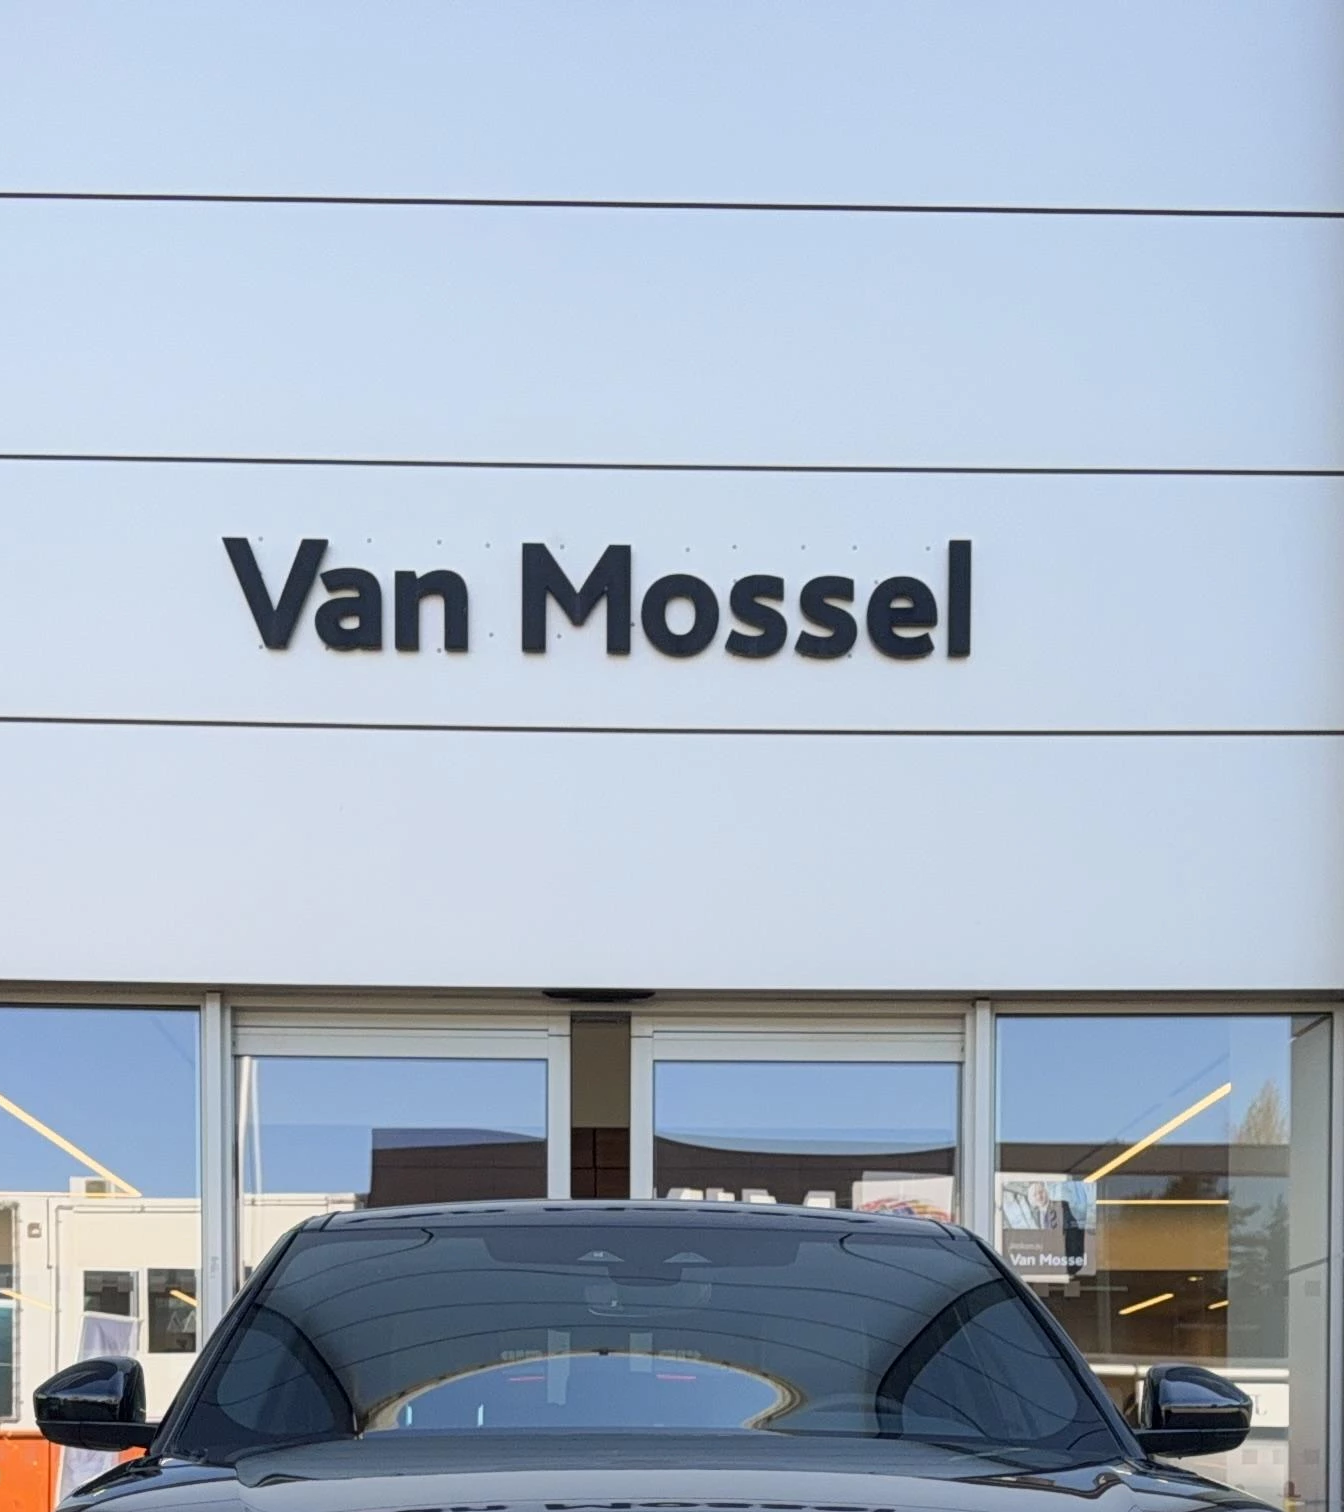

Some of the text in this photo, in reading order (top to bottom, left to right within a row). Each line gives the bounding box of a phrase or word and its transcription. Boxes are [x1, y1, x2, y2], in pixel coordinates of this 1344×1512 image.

[221, 537, 972, 659] Van Mossel
[1009, 1252, 1088, 1266] Van Mossel
